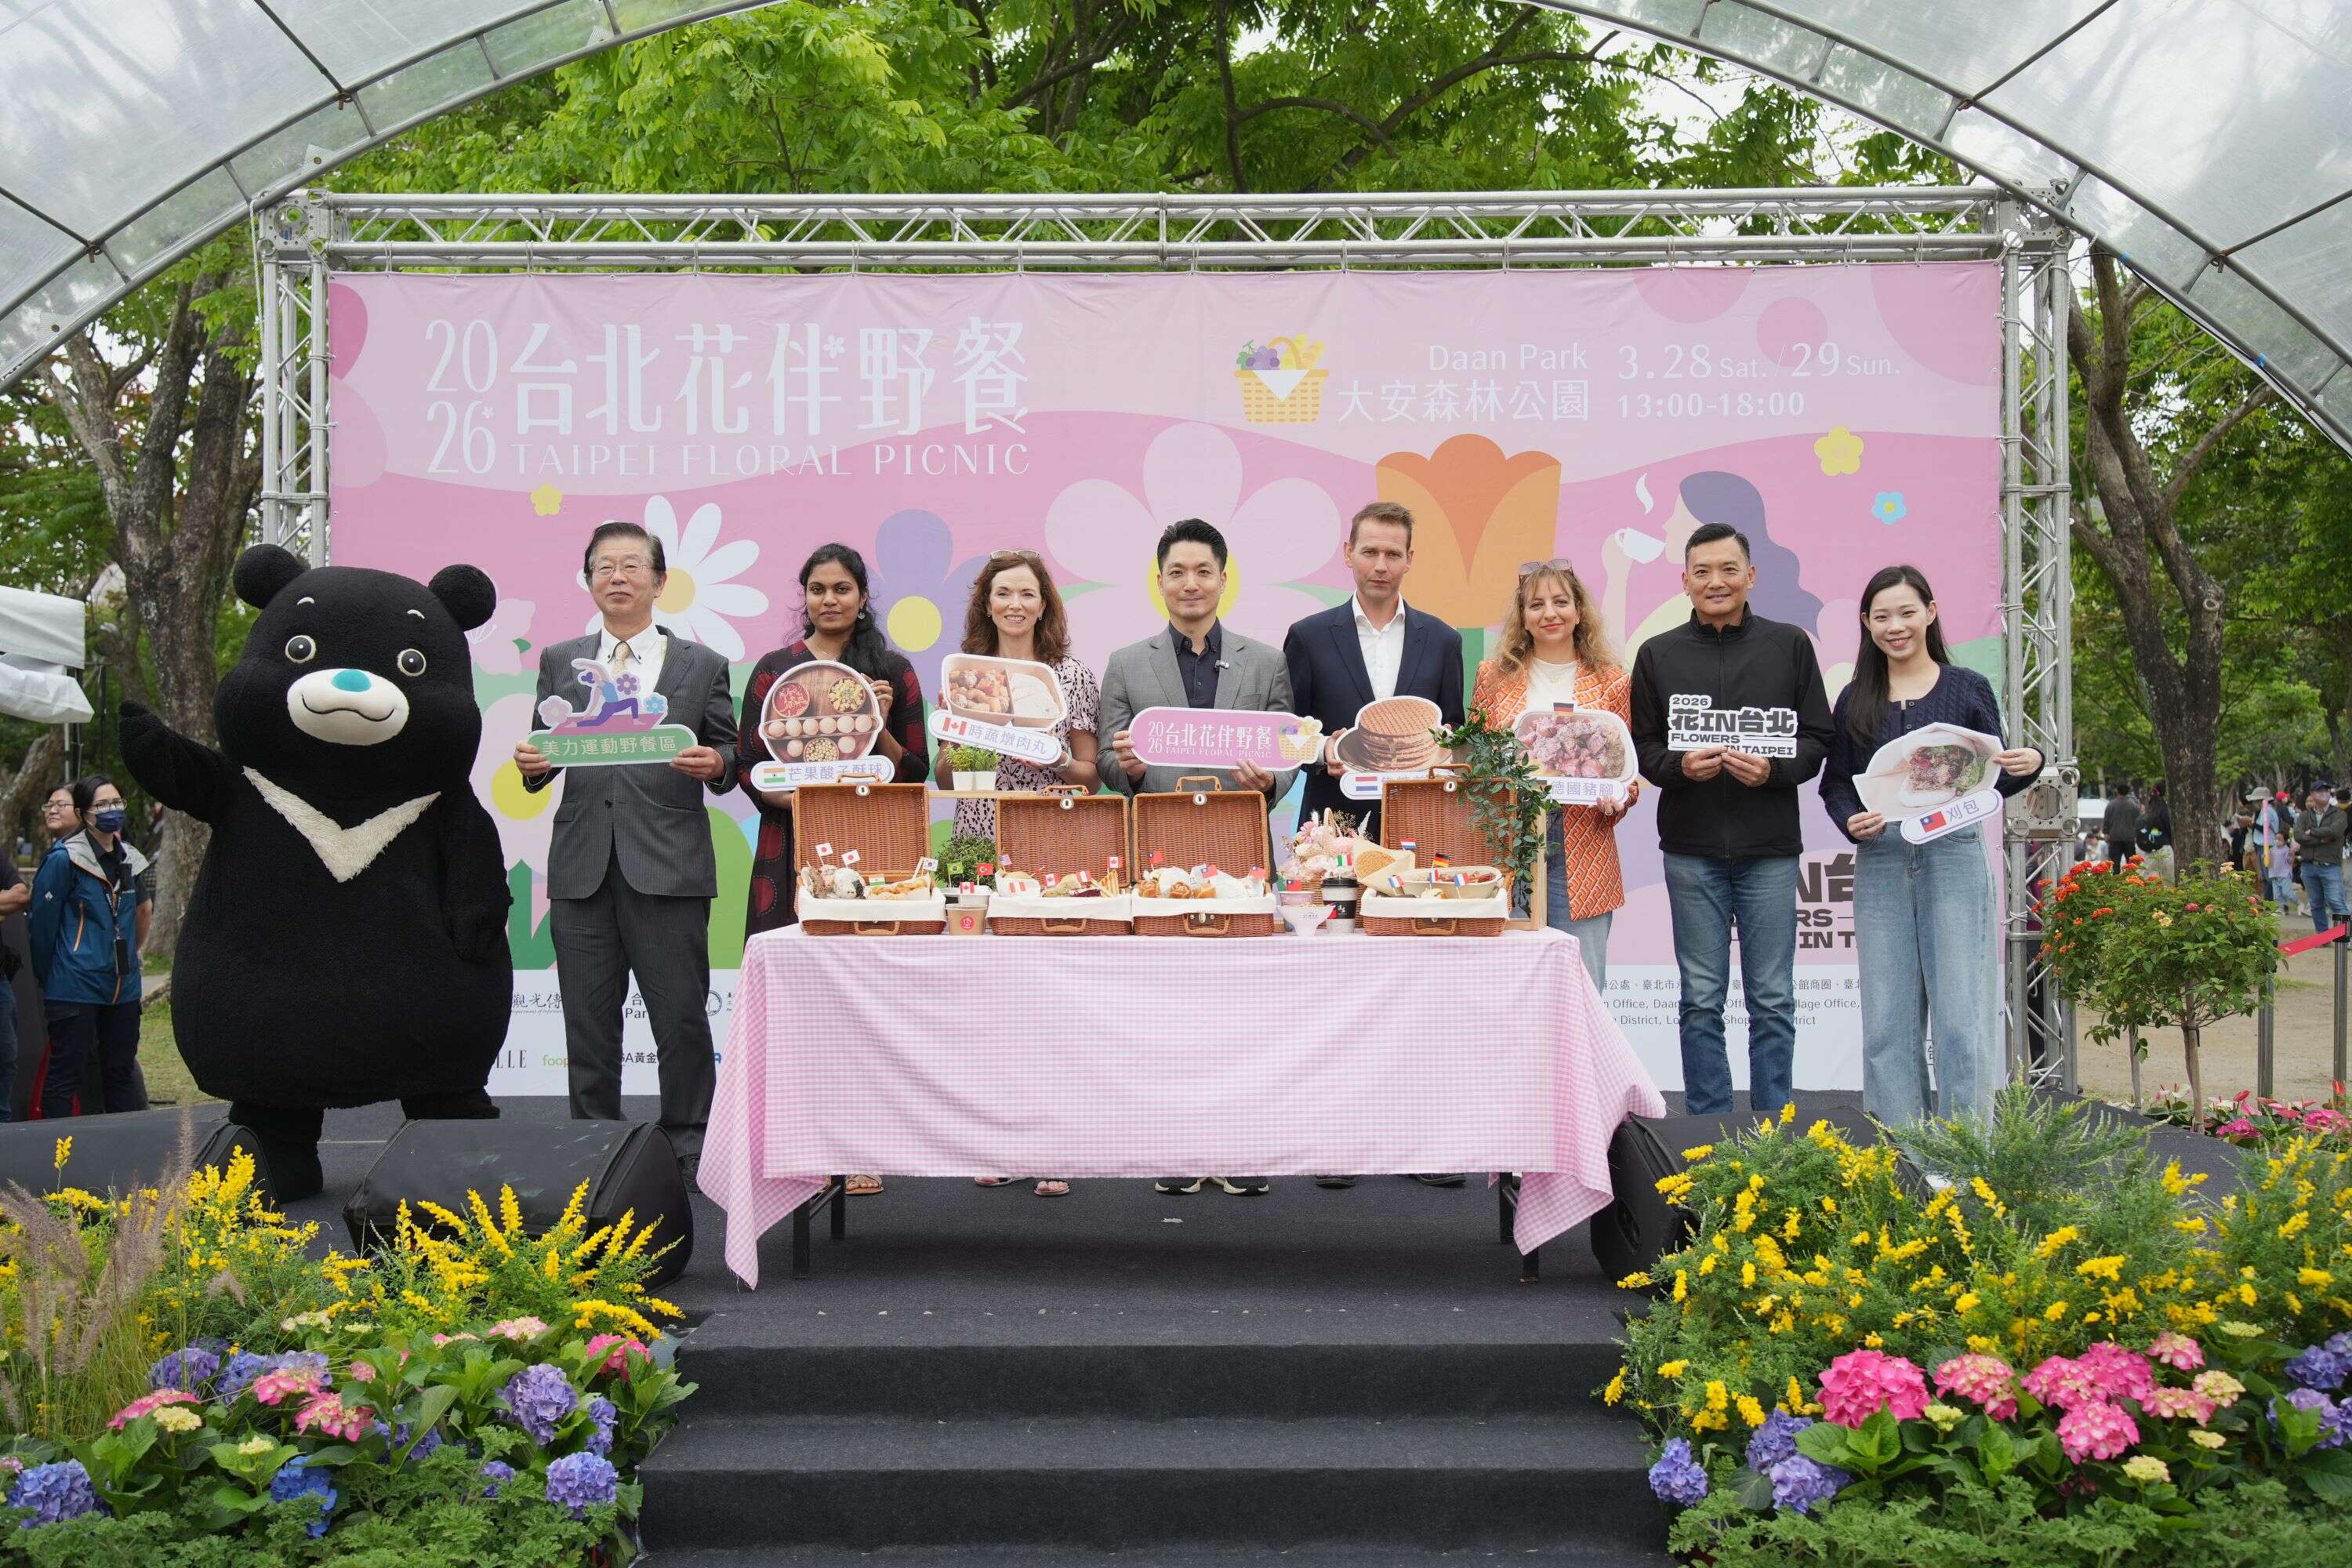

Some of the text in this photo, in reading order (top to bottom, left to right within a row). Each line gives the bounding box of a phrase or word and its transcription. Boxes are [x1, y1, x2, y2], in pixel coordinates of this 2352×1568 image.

[426, 319, 499, 393] 20
[1429, 342, 1588, 371] Daan Park
[1617, 344, 1712, 379] 3.28
[1719, 358, 1766, 379] Sat.
[1846, 355, 1900, 376] Sun.
[510, 317, 1029, 435] 台北花伴野餐
[1338, 379, 1588, 423] 大安森林公園
[1617, 391, 1805, 418] 13:00-18:00
[426, 401, 496, 474] 26
[510, 444, 1029, 476] TAIPEI FLORAL PICNIC
[1672, 697, 1708, 706] 2026
[1148, 720, 1164, 737] 20
[1671, 708, 1795, 734] 花IN台北
[543, 735, 677, 757] 美力運動野餐區
[1148, 738, 1163, 753] 26
[1166, 722, 1272, 750] 台北花伴野餐
[1671, 733, 1740, 743] FLOWERS
[1742, 746, 1793, 755] TAIPEI
[1947, 800, 1979, 821] 刈包
[1799, 931, 1833, 948] IN
[1613, 999, 1649, 1009] Office,
[1824, 999, 1860, 1009] Office,
[1621, 1014, 1661, 1025] District,
